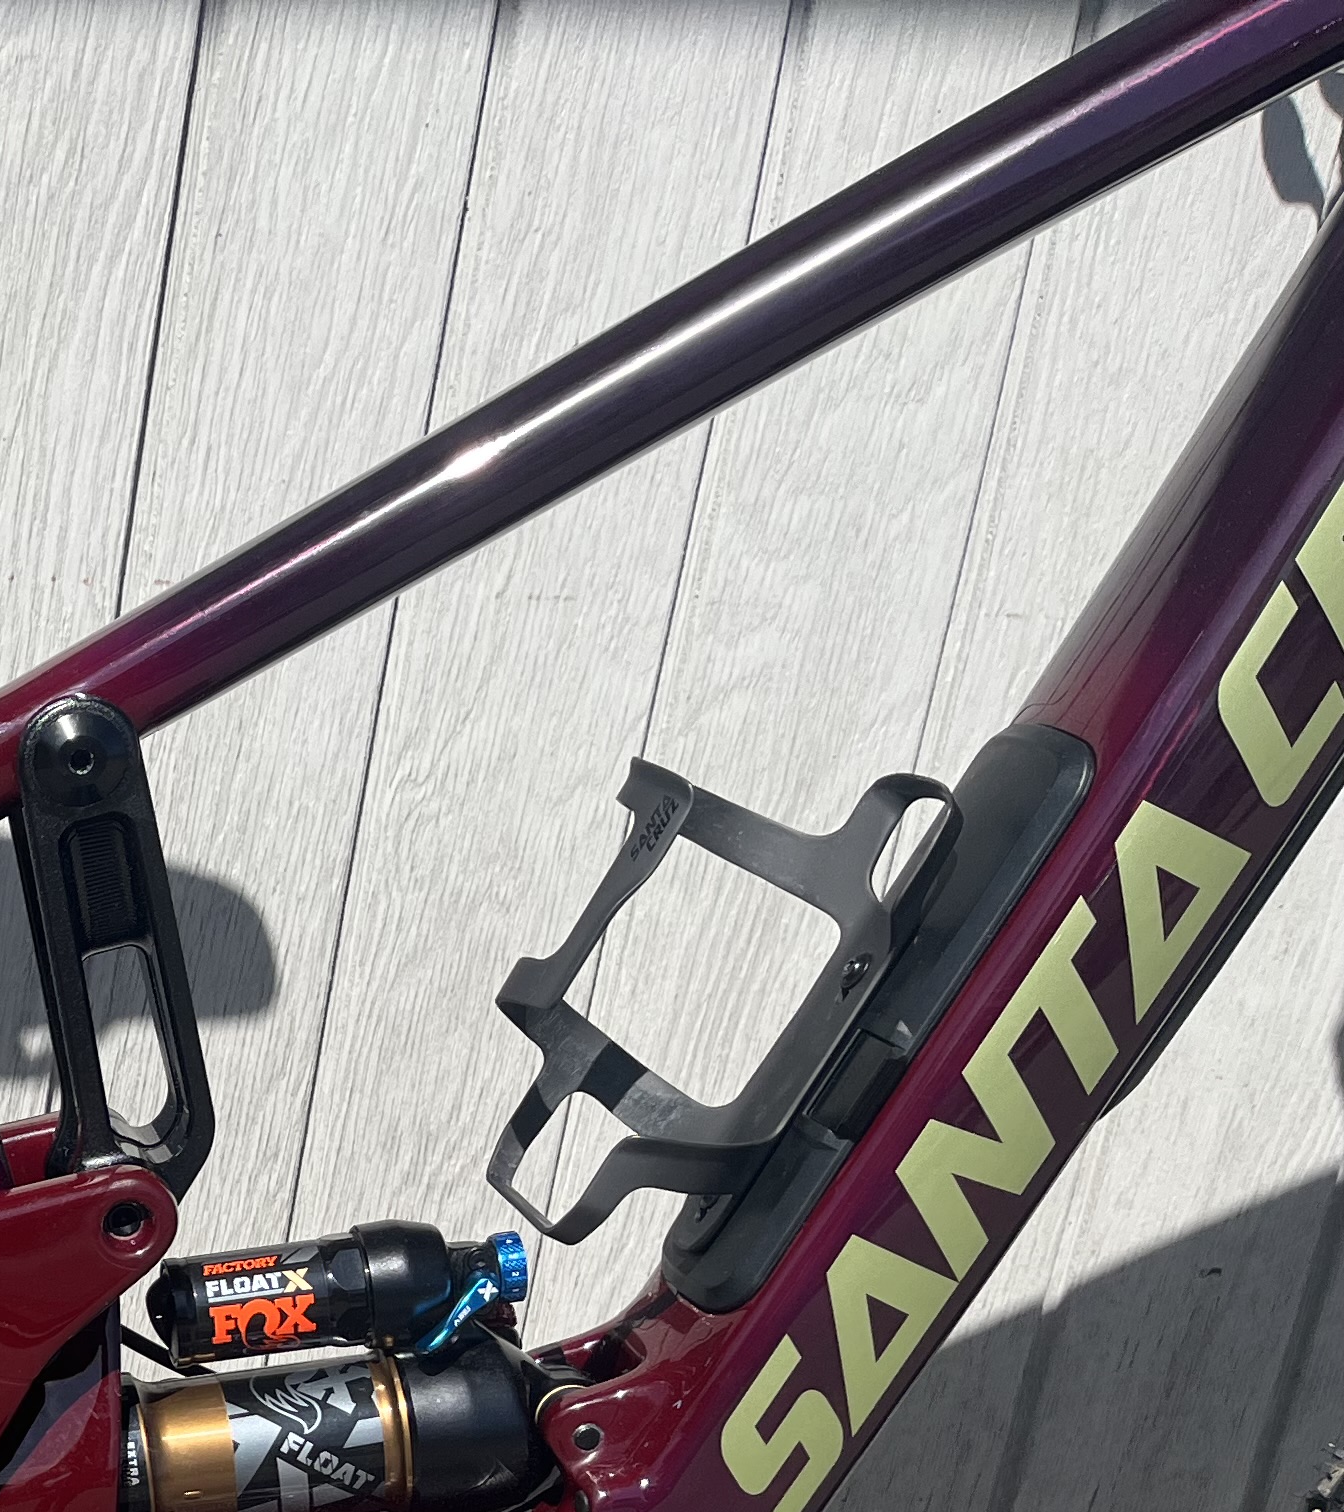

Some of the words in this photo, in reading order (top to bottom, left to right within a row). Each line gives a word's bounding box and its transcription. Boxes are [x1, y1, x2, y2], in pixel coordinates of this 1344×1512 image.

[630, 794, 672, 862] SANTA
[646, 799, 680, 852] CRUZ
[203, 1255, 278, 1277] FACTORY
[209, 1293, 317, 1350] FOX
[279, 1431, 376, 1490] FLOAT
